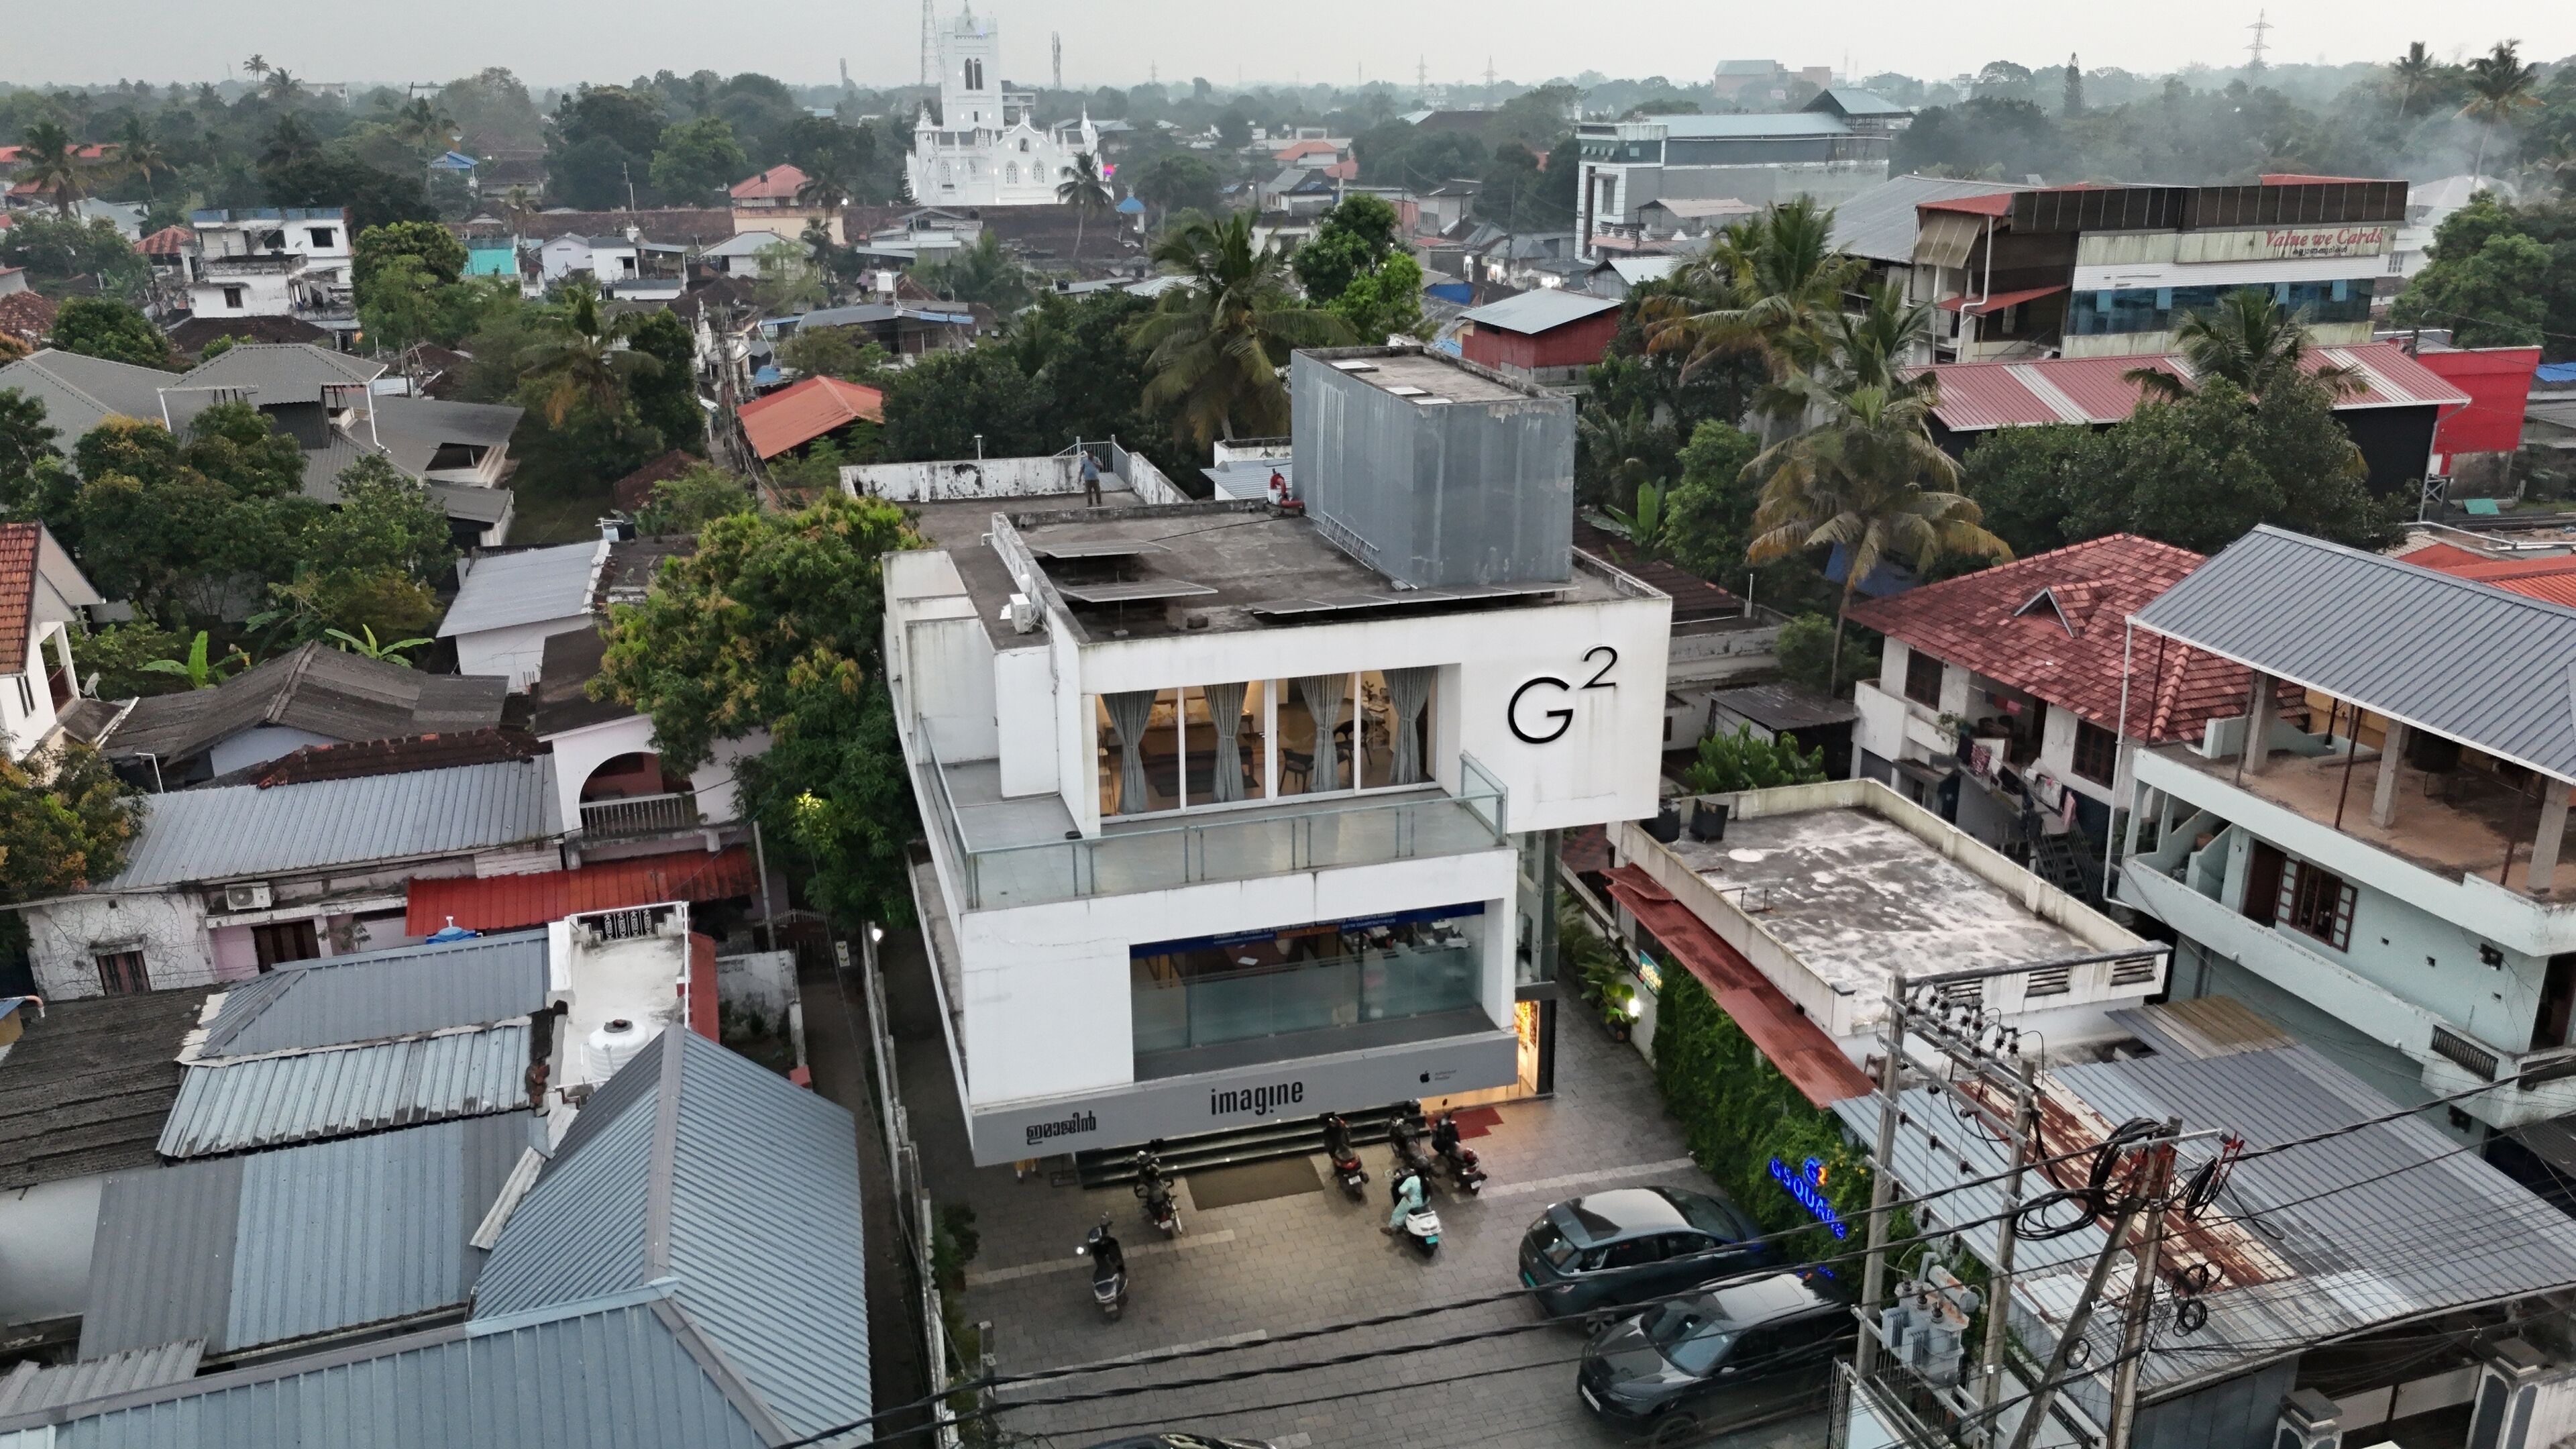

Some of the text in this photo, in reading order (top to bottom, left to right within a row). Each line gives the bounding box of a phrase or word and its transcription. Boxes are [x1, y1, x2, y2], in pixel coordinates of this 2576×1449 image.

[2265, 226, 2383, 248] Value we Cards
[1211, 1081, 1303, 1116] imagine
